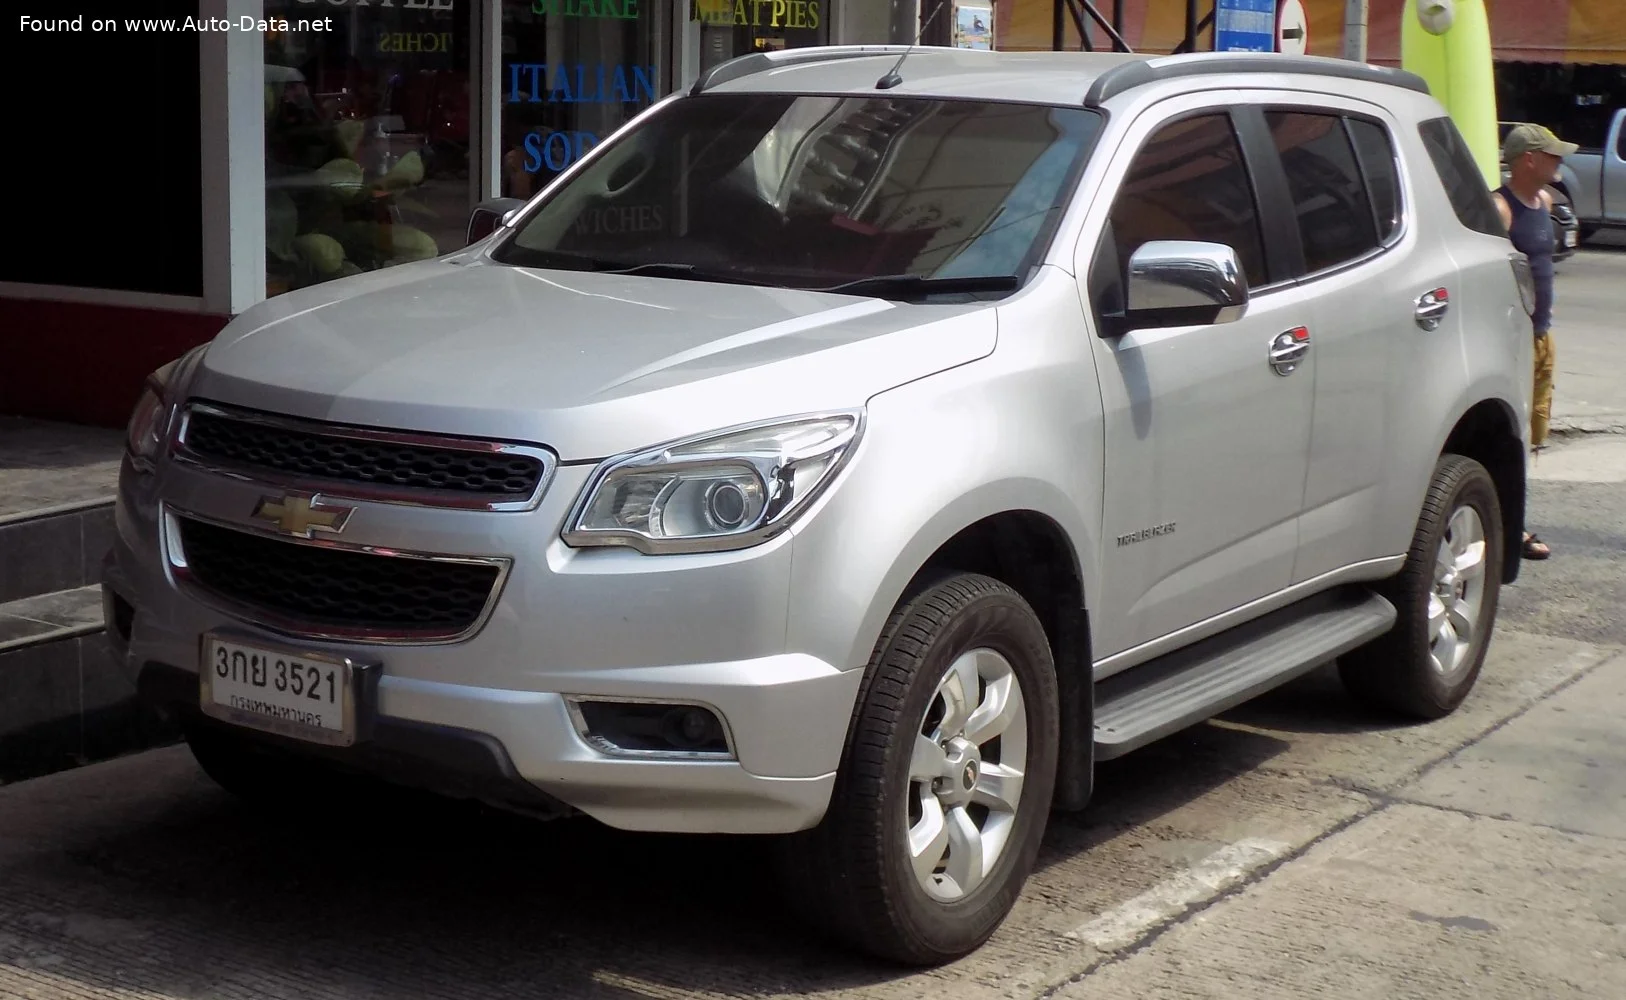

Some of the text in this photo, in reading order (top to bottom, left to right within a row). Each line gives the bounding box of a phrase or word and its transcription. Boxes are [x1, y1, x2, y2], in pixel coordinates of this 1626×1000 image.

[770, 0, 820, 30] PIES
[507, 61, 657, 104] ITALIAN
[523, 129, 600, 174] SOD
[216, 646, 335, 704] 3กย 3521
